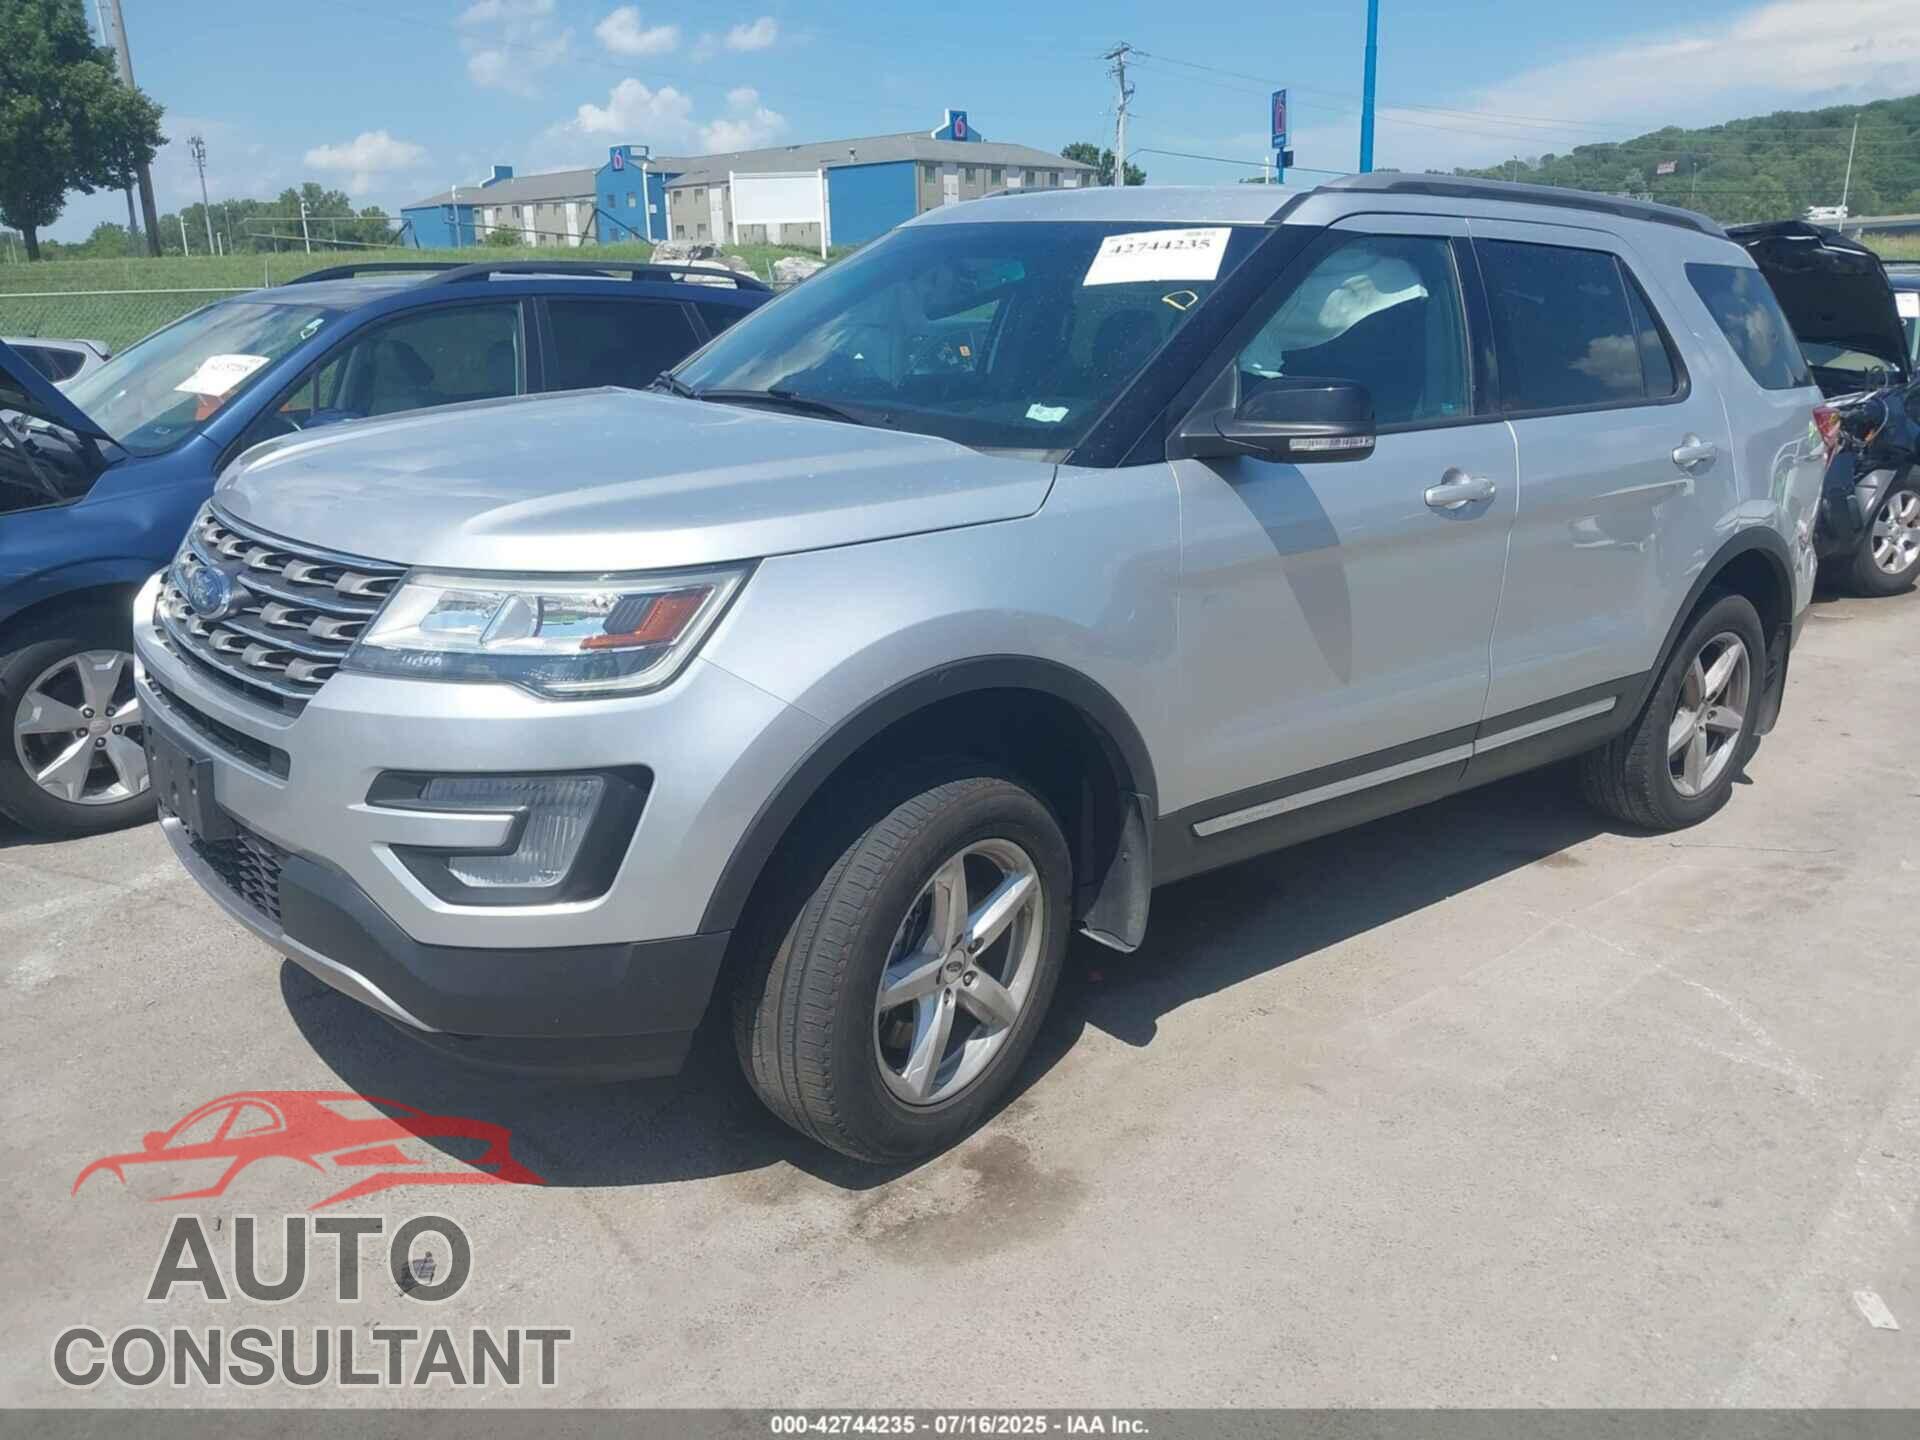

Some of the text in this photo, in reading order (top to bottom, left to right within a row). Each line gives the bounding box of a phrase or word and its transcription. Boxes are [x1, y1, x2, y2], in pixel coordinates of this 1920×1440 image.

[954, 115, 966, 138] 6
[613, 148, 623, 170] 6
[1109, 238, 1211, 254] 42744235
